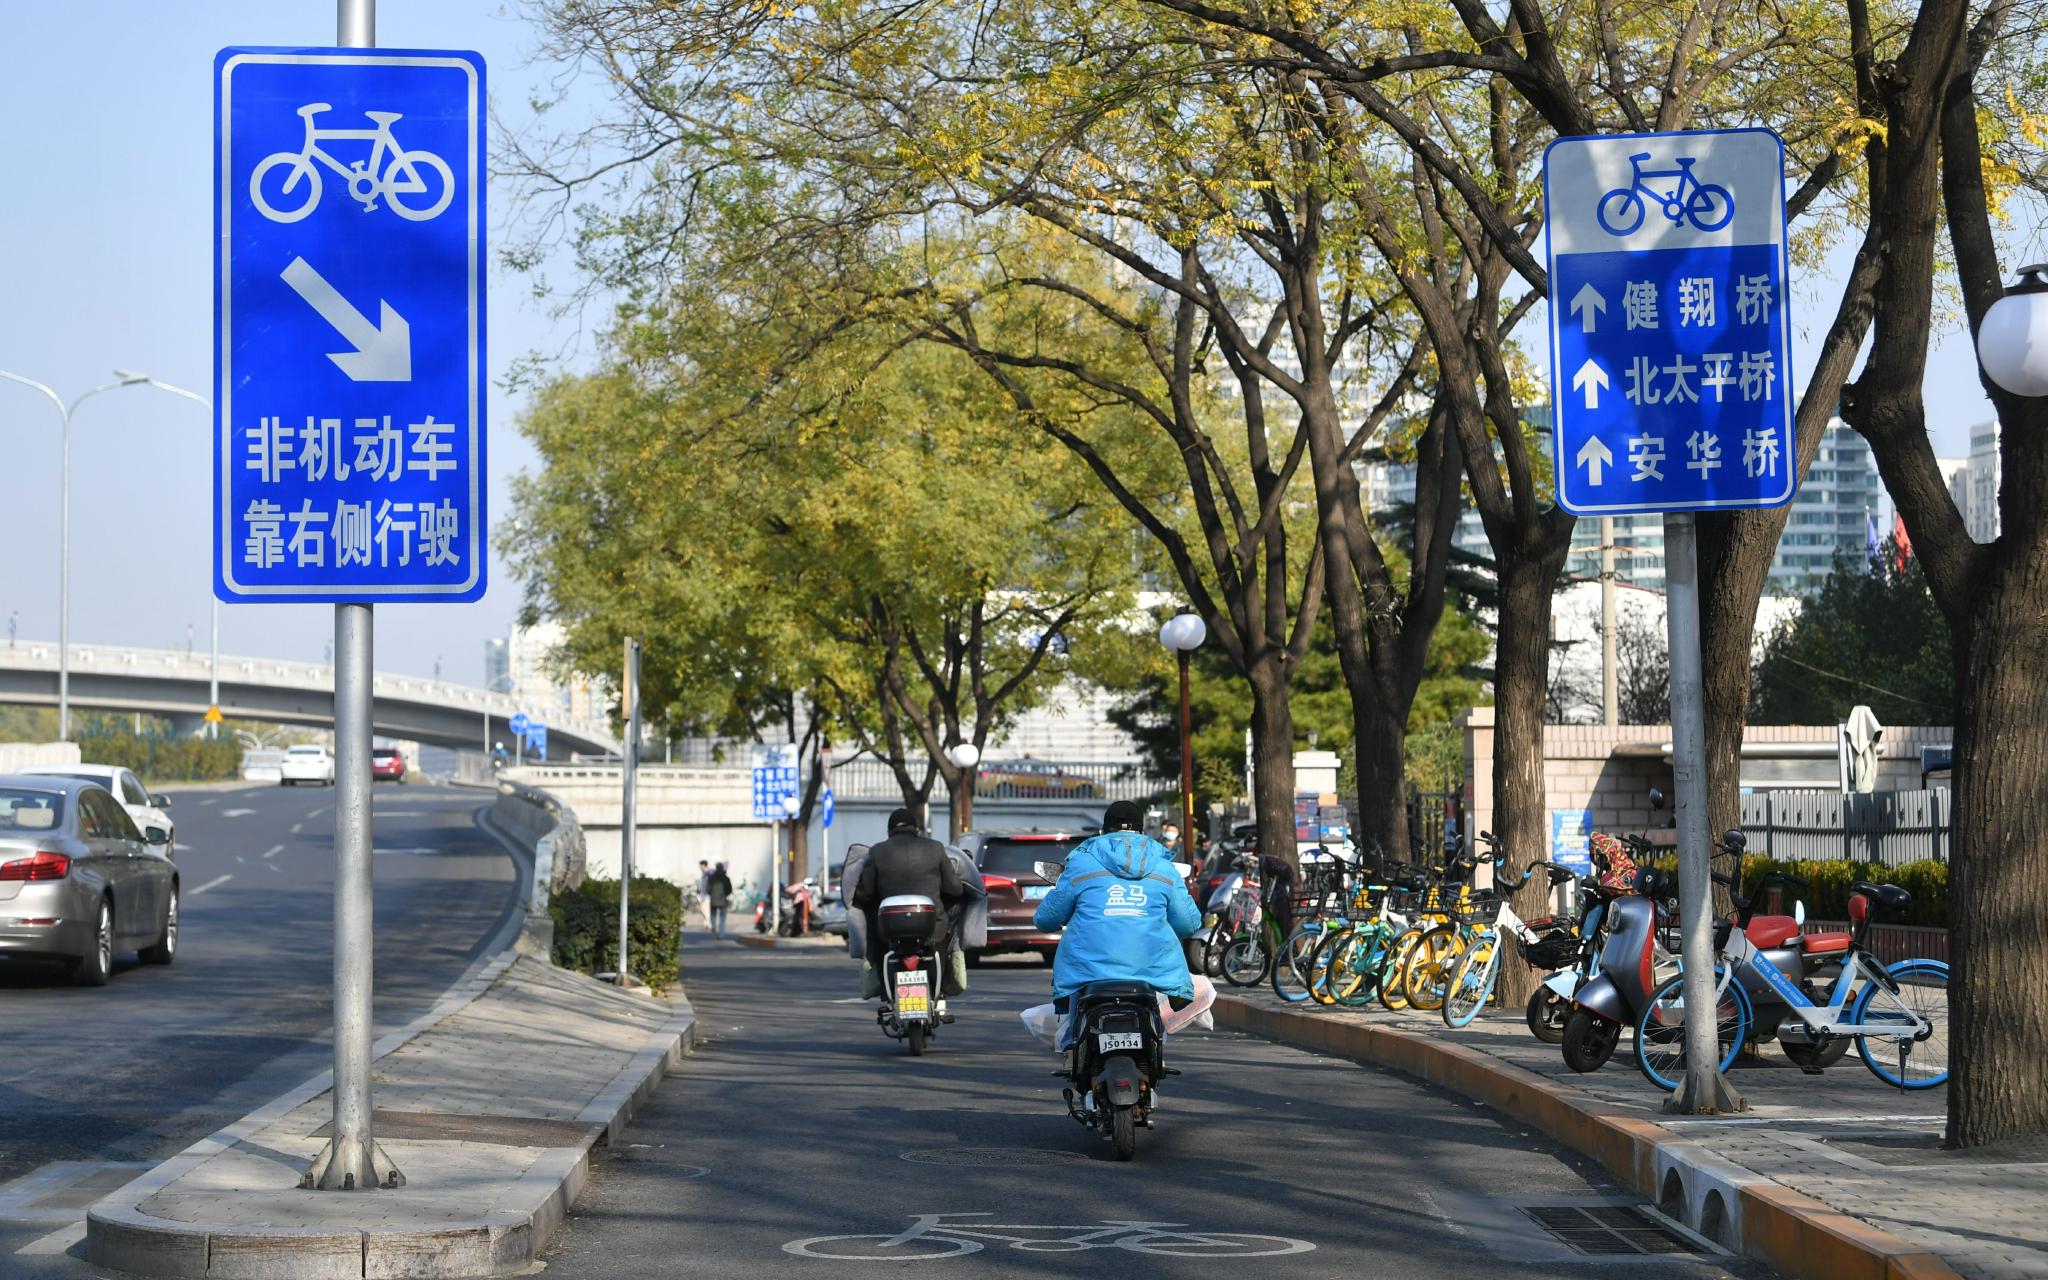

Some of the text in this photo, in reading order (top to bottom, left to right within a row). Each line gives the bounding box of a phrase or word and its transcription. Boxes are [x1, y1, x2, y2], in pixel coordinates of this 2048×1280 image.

[1622, 273, 1773, 331] 健翔桥
[1625, 350, 1776, 406] 北太平桥
[246, 415, 457, 482] 非机动车
[1628, 427, 1780, 482] 安华桥
[244, 498, 460, 568] 靠右侧行驶
[1106, 884, 1148, 906] 盒马
[1103, 1040, 1139, 1051] JS0134
